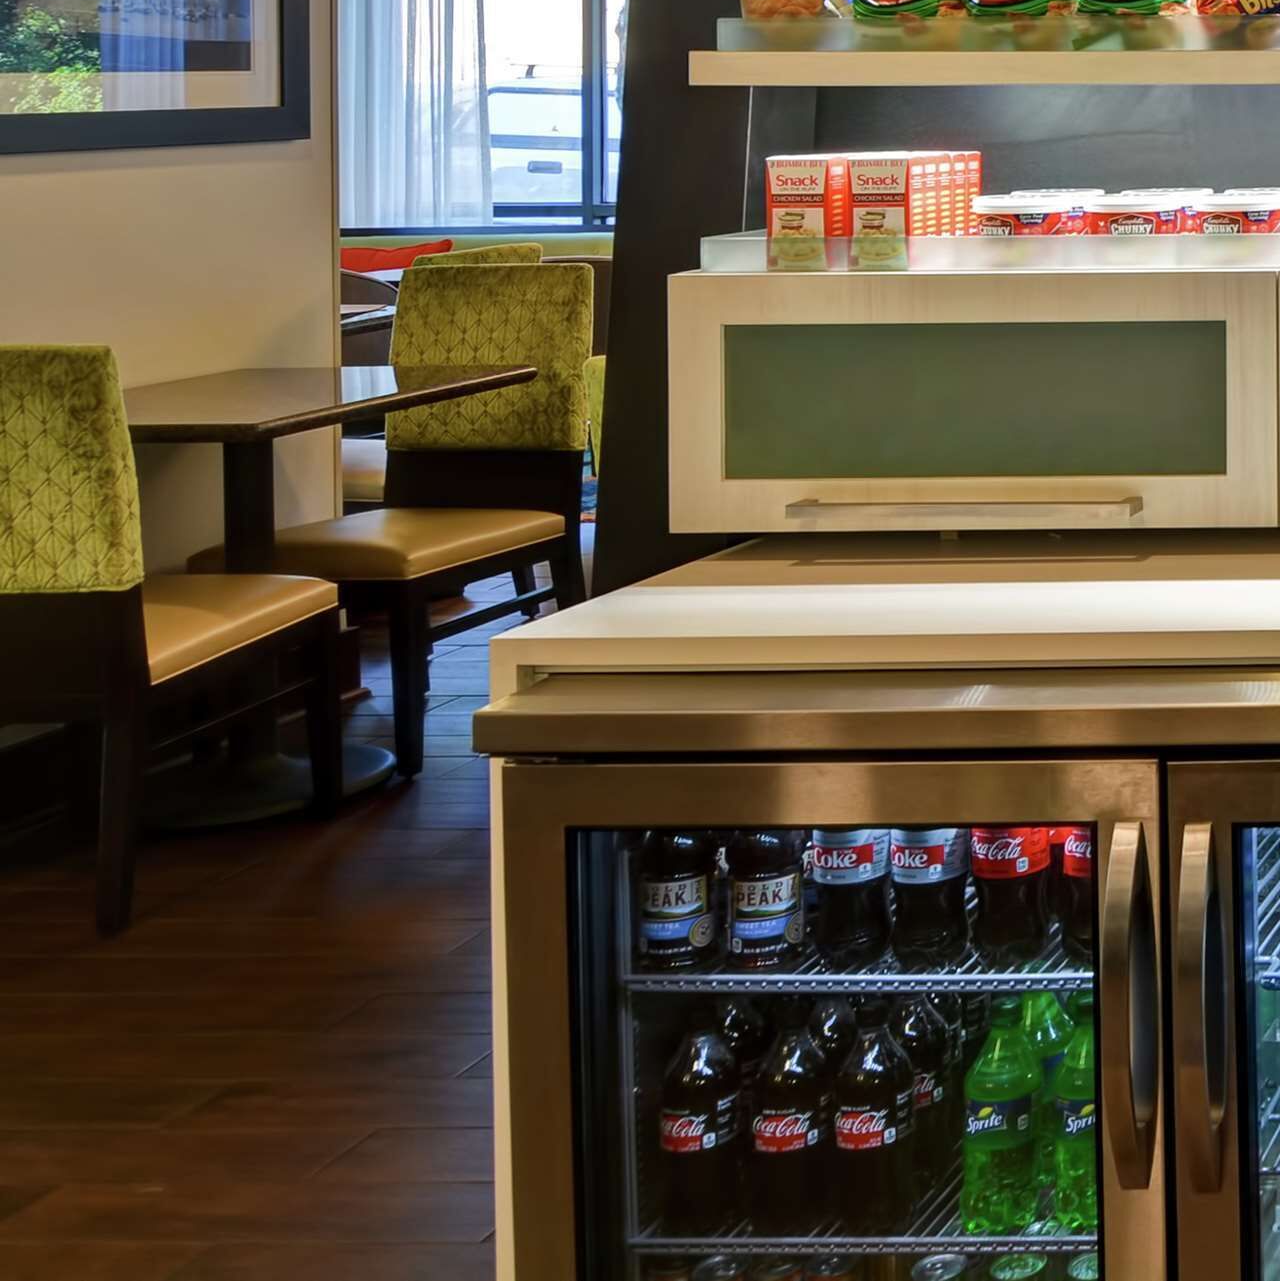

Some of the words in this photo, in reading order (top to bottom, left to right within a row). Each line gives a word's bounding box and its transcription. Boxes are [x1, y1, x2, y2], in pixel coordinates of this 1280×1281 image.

[775, 174, 819, 187] Snack
[856, 174, 900, 186] Snack
[1111, 223, 1153, 236] CHUNKY
[814, 845, 858, 869] Coke
[891, 845, 928, 868] Coke
[736, 888, 784, 906] PEAK
[753, 1111, 813, 1138] Coca-Cola
[966, 1113, 1003, 1133] Sprite
